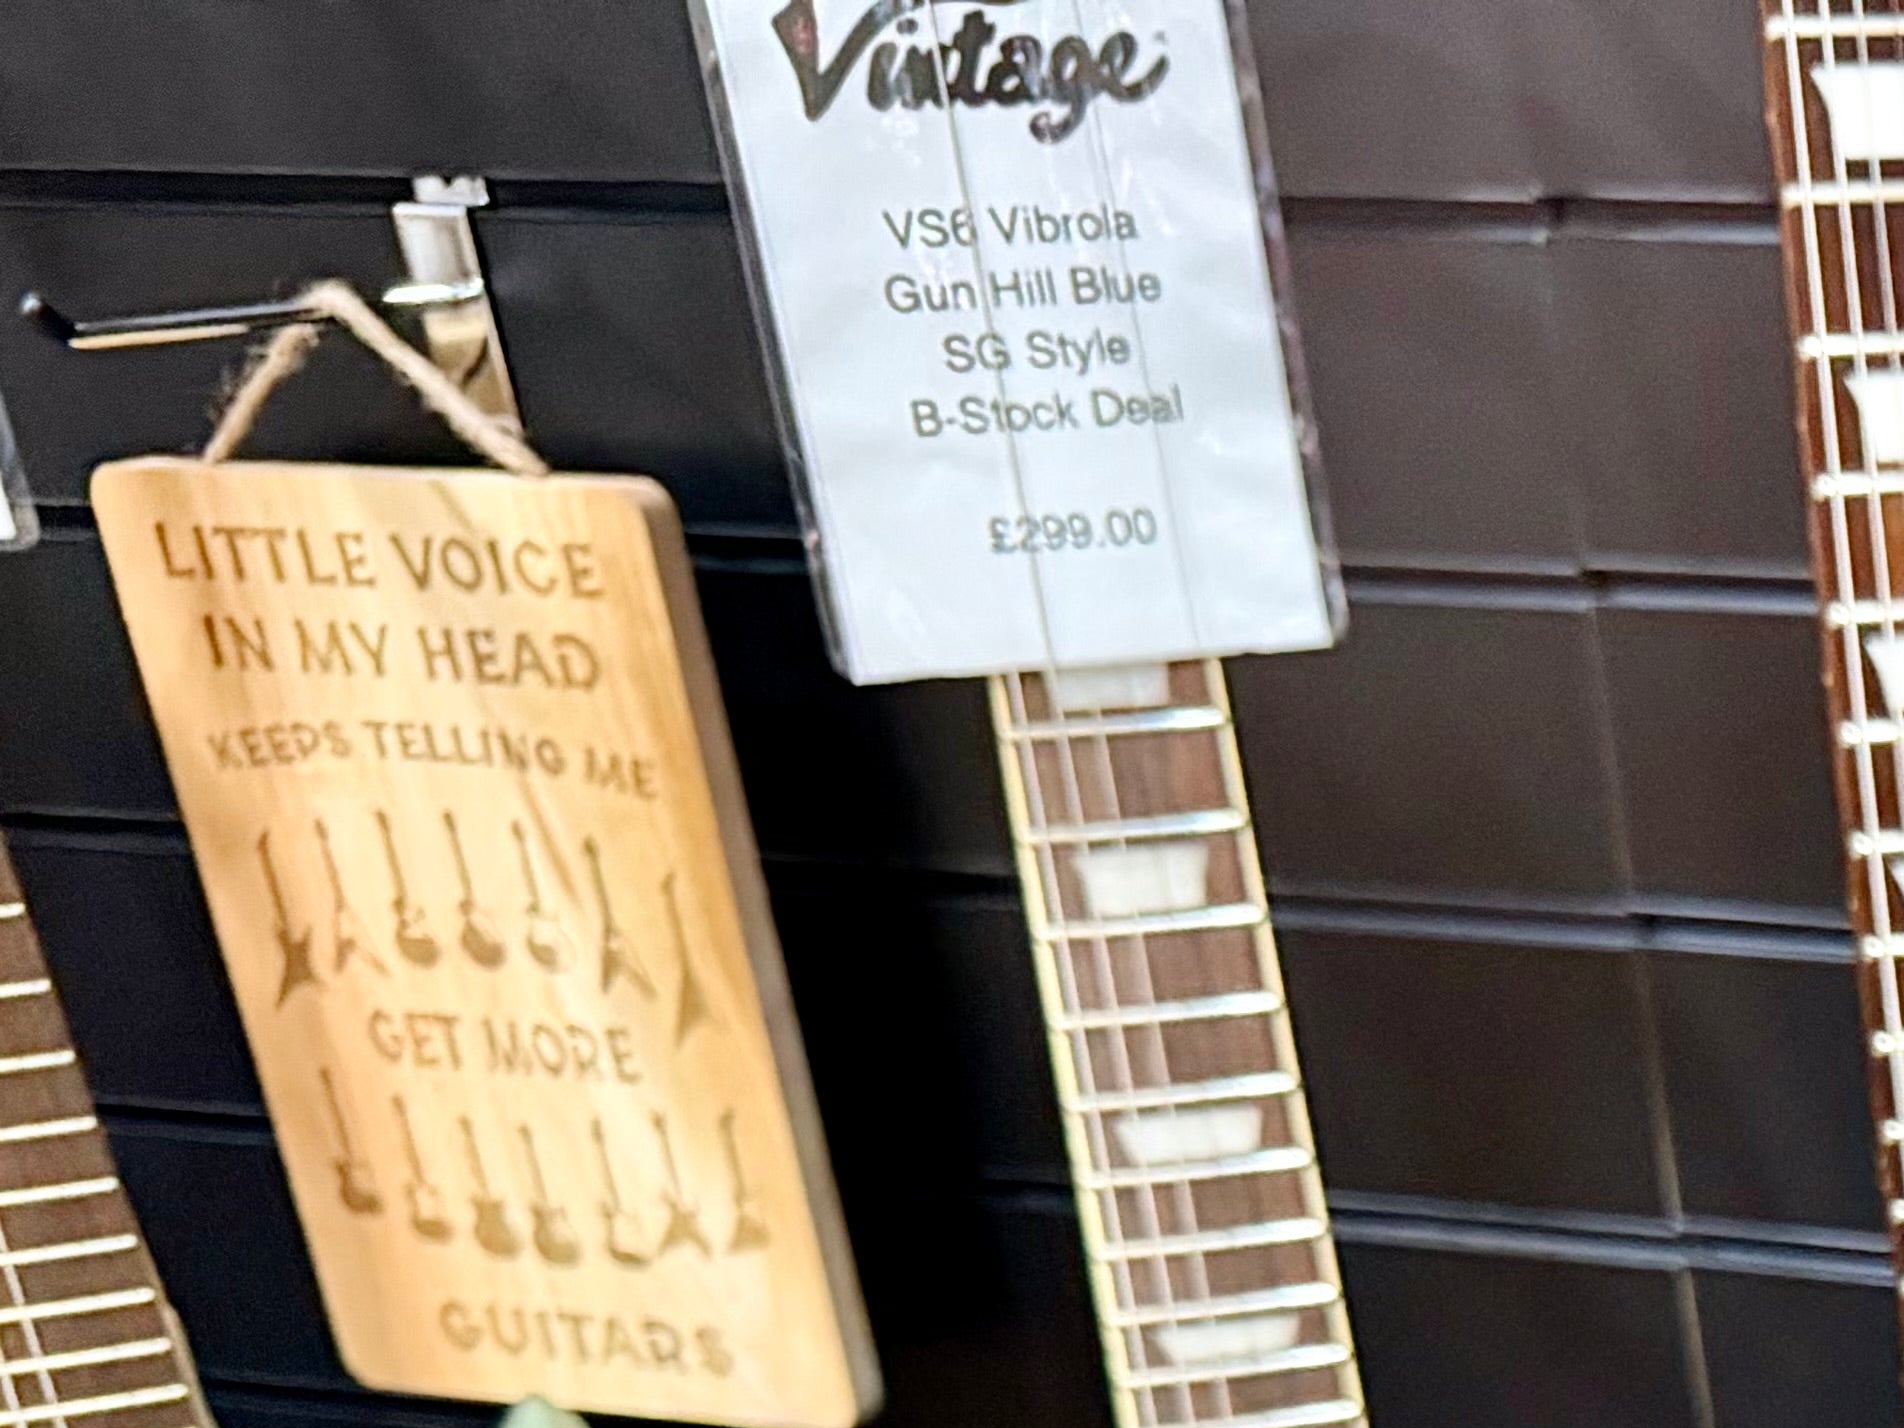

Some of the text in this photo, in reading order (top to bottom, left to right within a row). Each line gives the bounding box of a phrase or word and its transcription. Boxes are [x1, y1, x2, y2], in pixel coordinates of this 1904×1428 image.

[771, 0, 1170, 144] Vintage
[883, 205, 1138, 251] VS6 Vibrola
[884, 266, 1162, 314] Gun Hill Blue
[943, 328, 1131, 376] SG Style
[911, 384, 1184, 438] B-Stock Deal
[152, 521, 607, 600] LITTLE VOICE
[987, 508, 1157, 555] £299.00
[202, 614, 600, 694] IN MY HEAD
[206, 720, 660, 803] KEEPS TELLING ME
[368, 1008, 644, 1087] GET MORE
[438, 1300, 735, 1380] GUITARS
